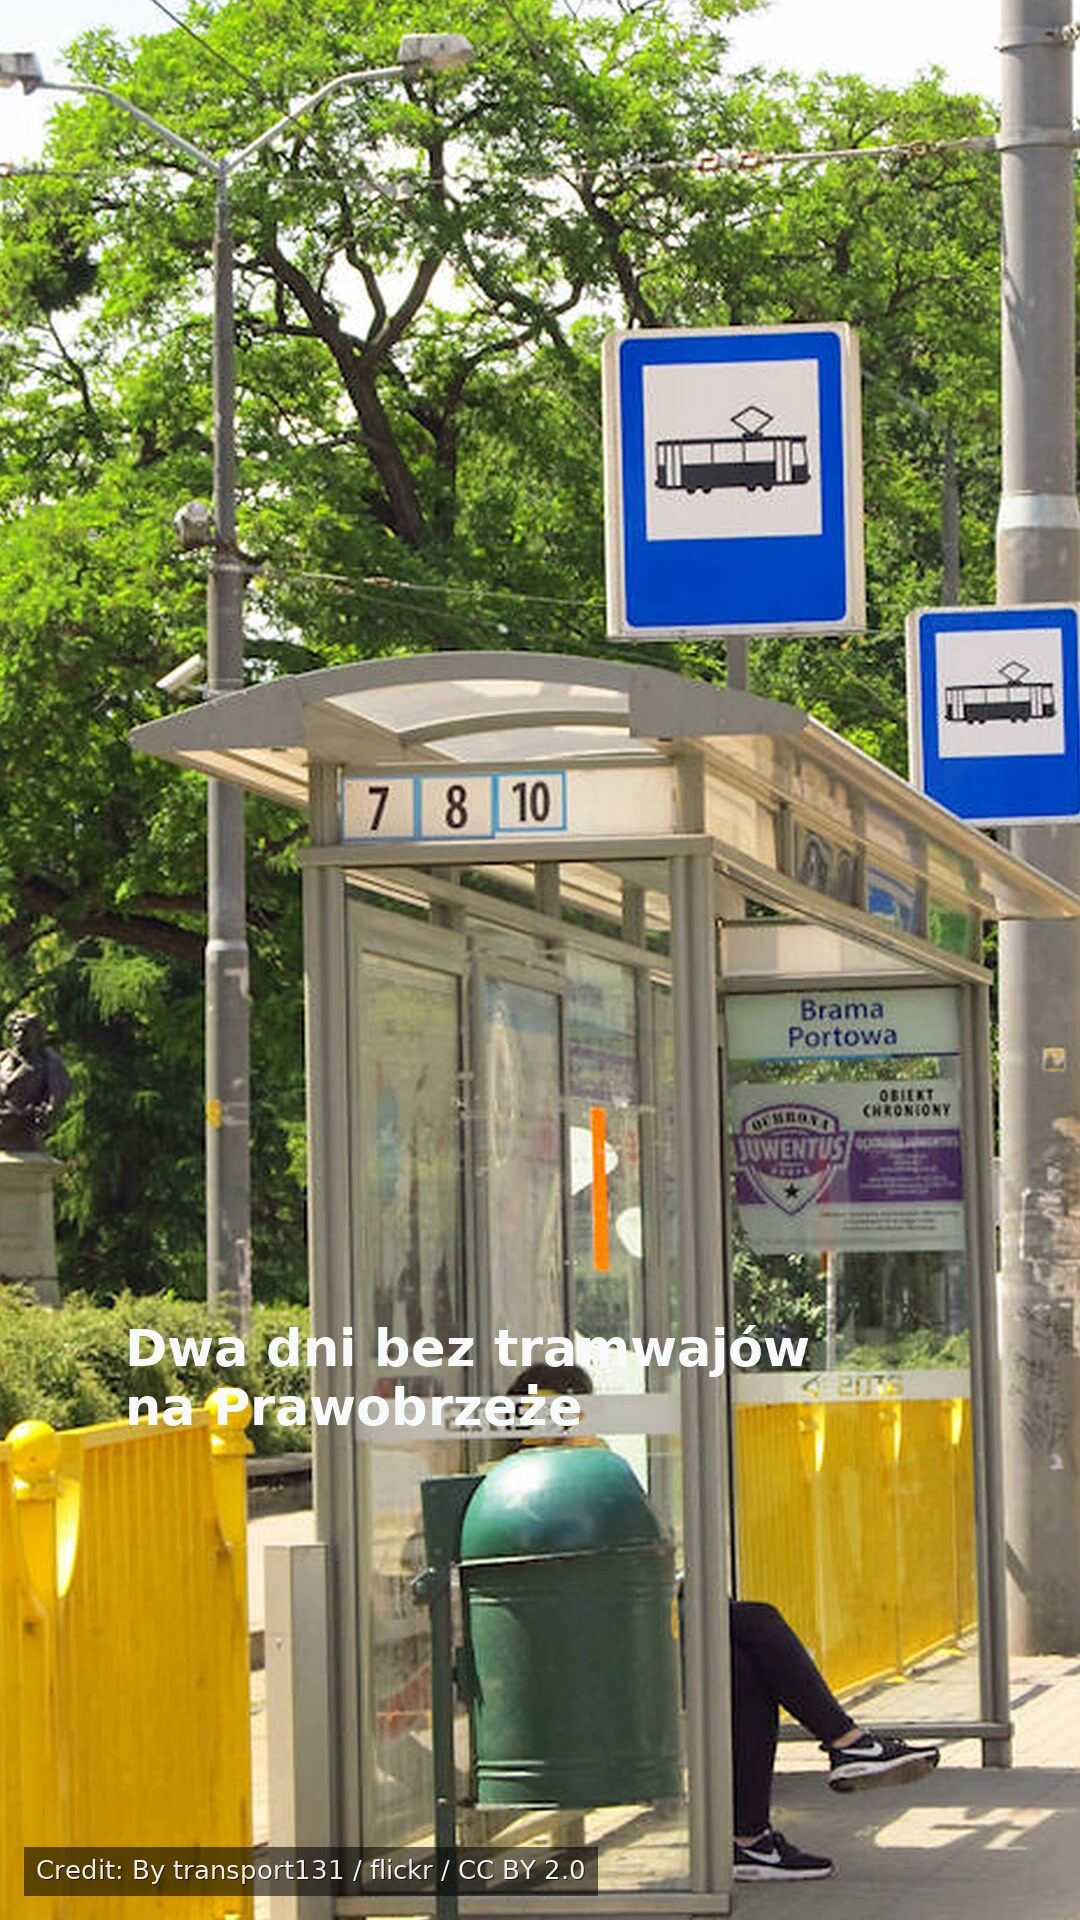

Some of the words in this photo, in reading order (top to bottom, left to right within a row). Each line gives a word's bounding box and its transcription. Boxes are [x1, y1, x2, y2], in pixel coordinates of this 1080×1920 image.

[367, 786, 390, 831] 7
[445, 784, 468, 829] 8
[512, 780, 550, 822] 10
[800, 999, 884, 1021] Brama
[788, 1026, 898, 1049] Portowa
[879, 1088, 934, 1102] OBIEKT
[862, 1103, 951, 1118] CHRONIONY
[737, 1135, 847, 1163] JUWENTUS
